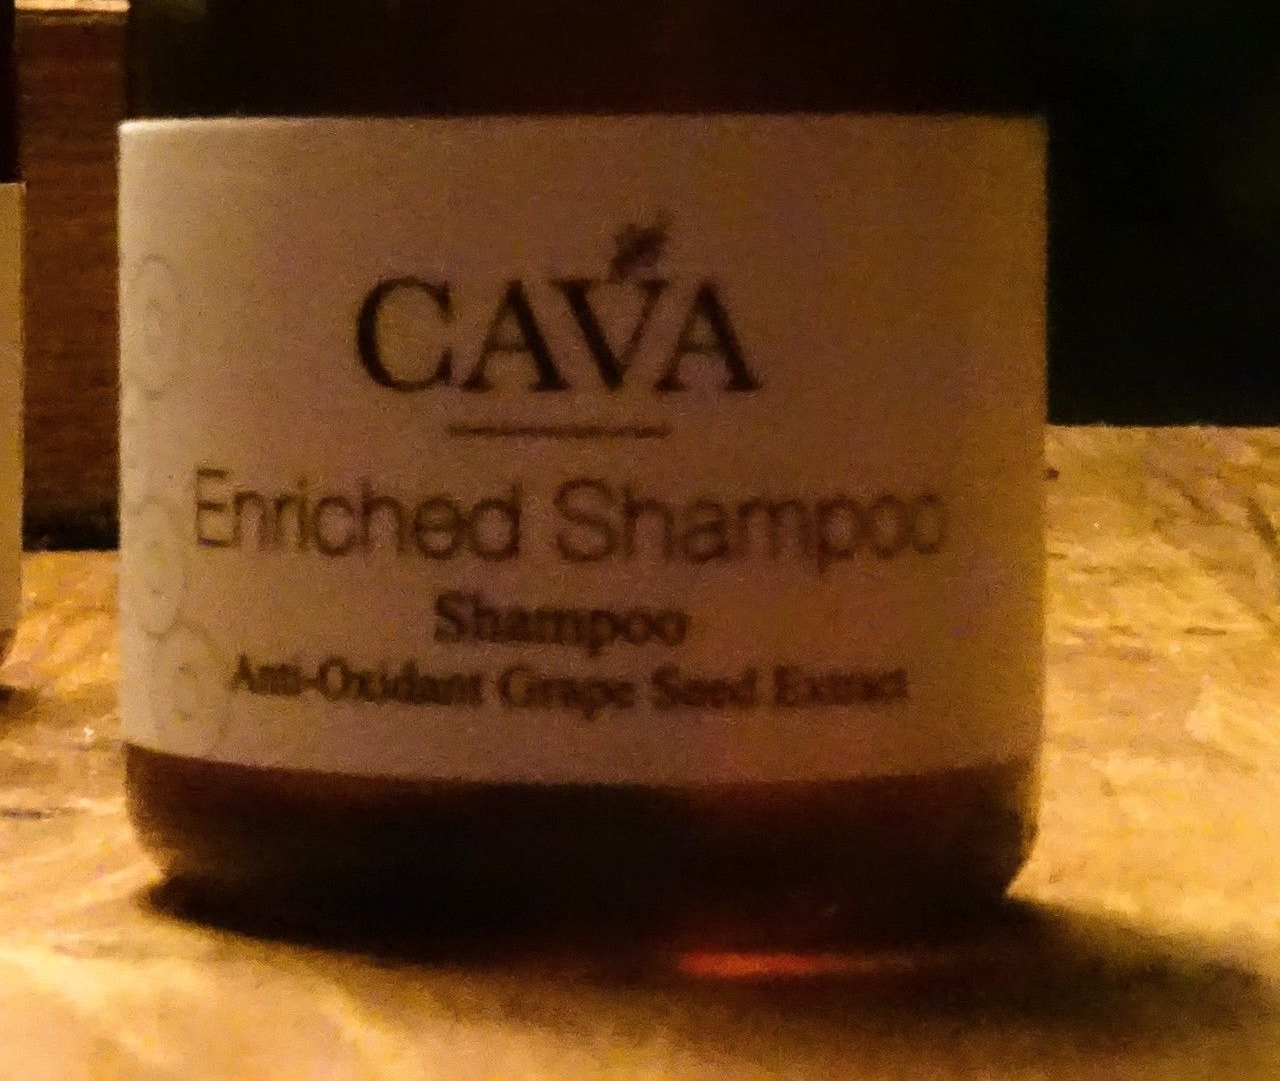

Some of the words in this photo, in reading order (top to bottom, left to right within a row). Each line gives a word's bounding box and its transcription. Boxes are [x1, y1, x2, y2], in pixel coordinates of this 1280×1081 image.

[354, 274, 764, 393] CAVA
[192, 467, 521, 561] Enriched
[552, 479, 950, 573] Shampoo
[432, 590, 692, 657] Shampoo
[228, 651, 485, 707] Anti-Oxidant
[496, 664, 635, 716] Grape
[652, 666, 762, 709] Seed
[772, 665, 911, 705] Extract
